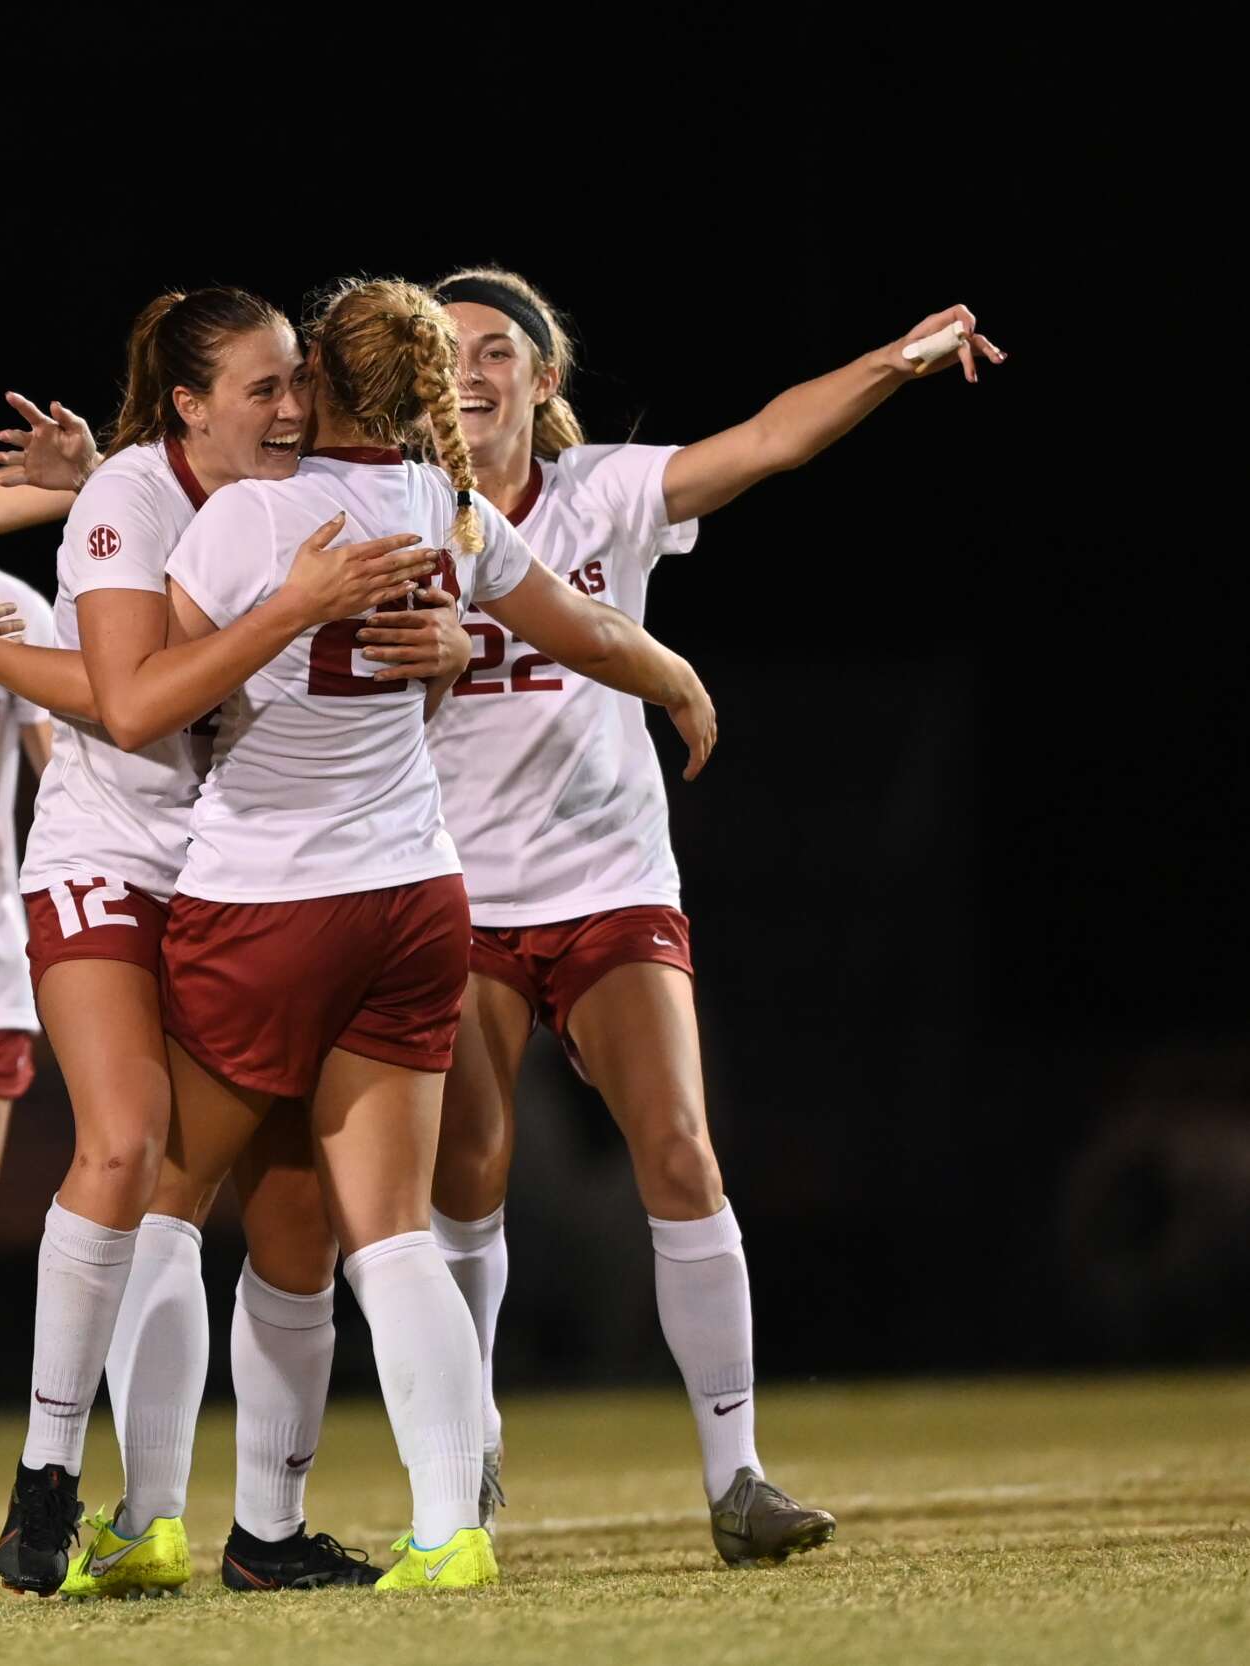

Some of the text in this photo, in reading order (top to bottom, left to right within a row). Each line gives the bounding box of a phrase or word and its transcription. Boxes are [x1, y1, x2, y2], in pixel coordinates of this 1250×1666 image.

[90, 527, 117, 557] SEC
[452, 623, 563, 697] 22
[49, 877, 139, 939] 12
